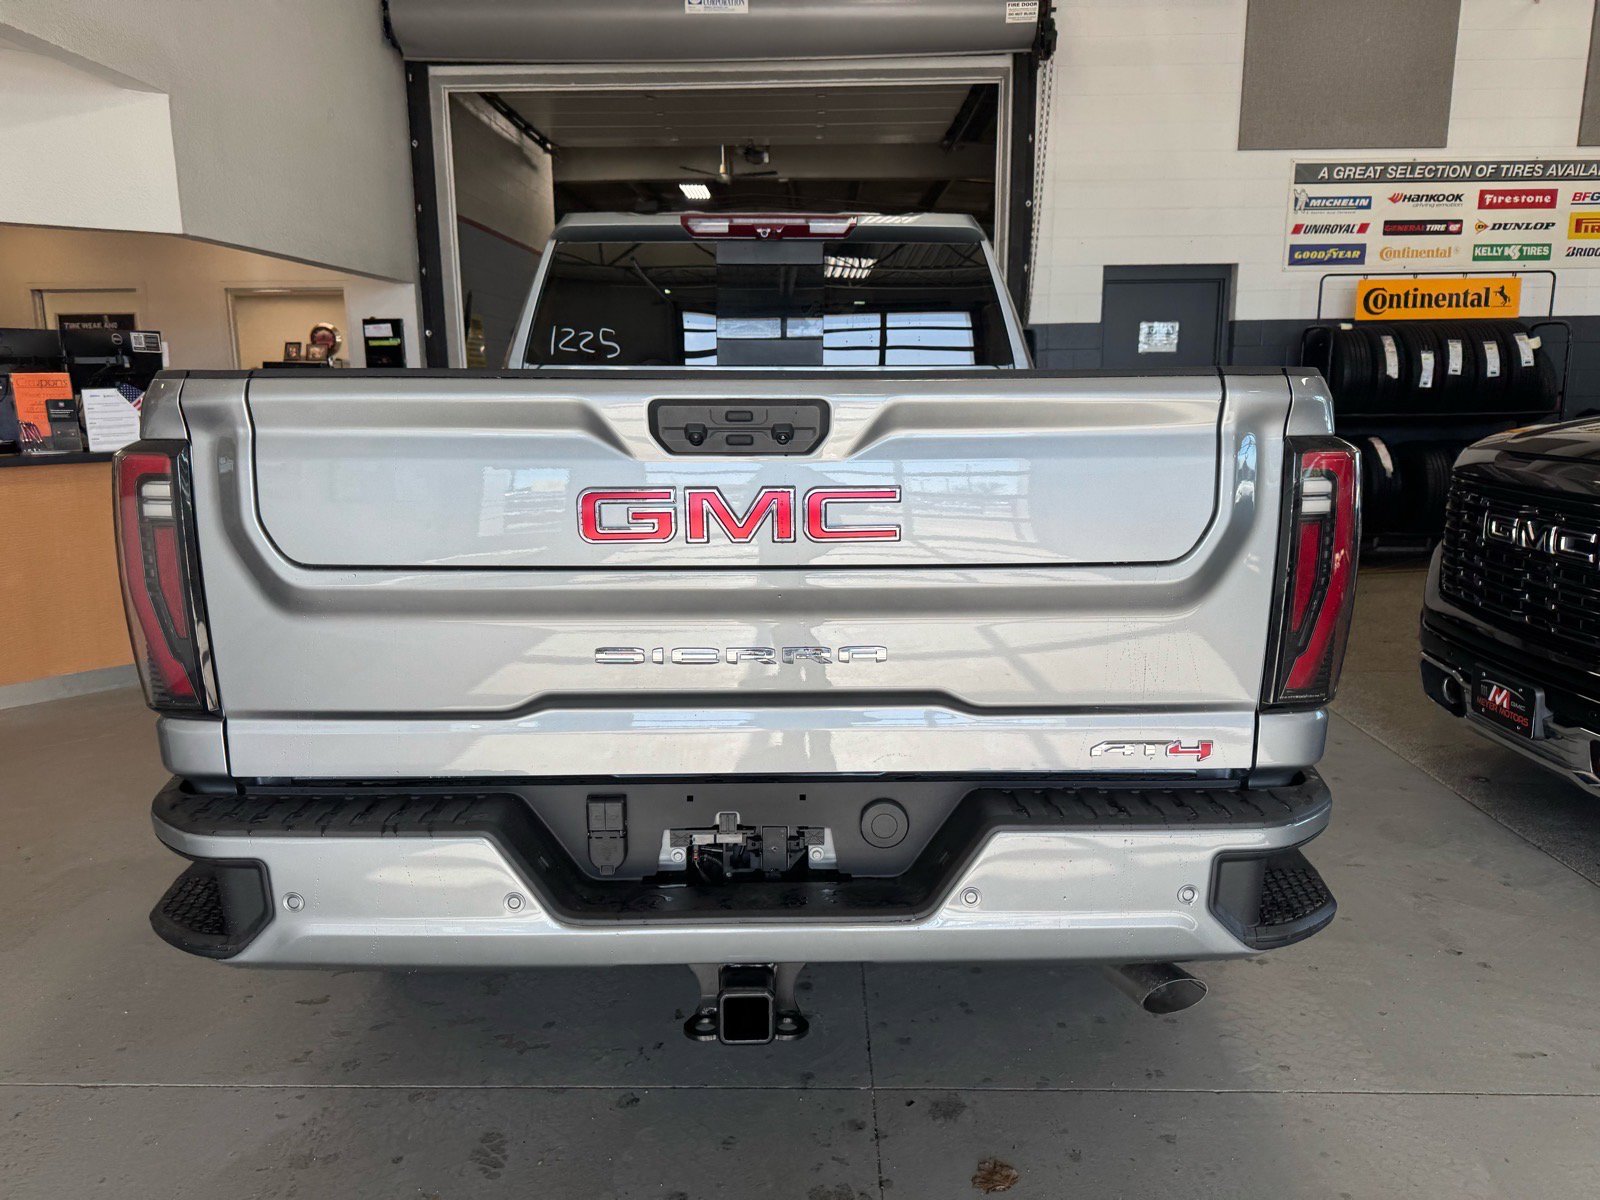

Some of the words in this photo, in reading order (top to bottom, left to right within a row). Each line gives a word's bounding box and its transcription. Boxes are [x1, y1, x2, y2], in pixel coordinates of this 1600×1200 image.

[1318, 166, 1329, 179] A
[1333, 166, 1384, 179] GREAT
[1386, 165, 1472, 179] SELECTION
[1475, 164, 1497, 178] OF
[1500, 164, 1544, 177] TIRES
[1546, 163, 1600, 177] AVAILA
[1309, 198, 1370, 207] MICHELIN
[1484, 194, 1552, 206] Firestone
[1303, 223, 1357, 235] UNIROYAL
[1384, 224, 1425, 232] GENERAL
[1425, 224, 1447, 232] TIRE
[1489, 222, 1556, 231] DUNLOP
[1294, 249, 1361, 260] GOODYEAR
[1379, 245, 1452, 261] Continental
[1474, 246, 1504, 257] KELLY
[1522, 245, 1550, 256] TIRES
[1362, 286, 1491, 316] Continental
[550, 325, 621, 359] 1225
[576, 484, 902, 545] GMC
[1483, 510, 1597, 564] GMC
[594, 645, 888, 665] SIERRA
[1476, 696, 1498, 713] MEYER
[1499, 707, 1529, 727] MOTORS
[1089, 739, 1214, 762] AT4
